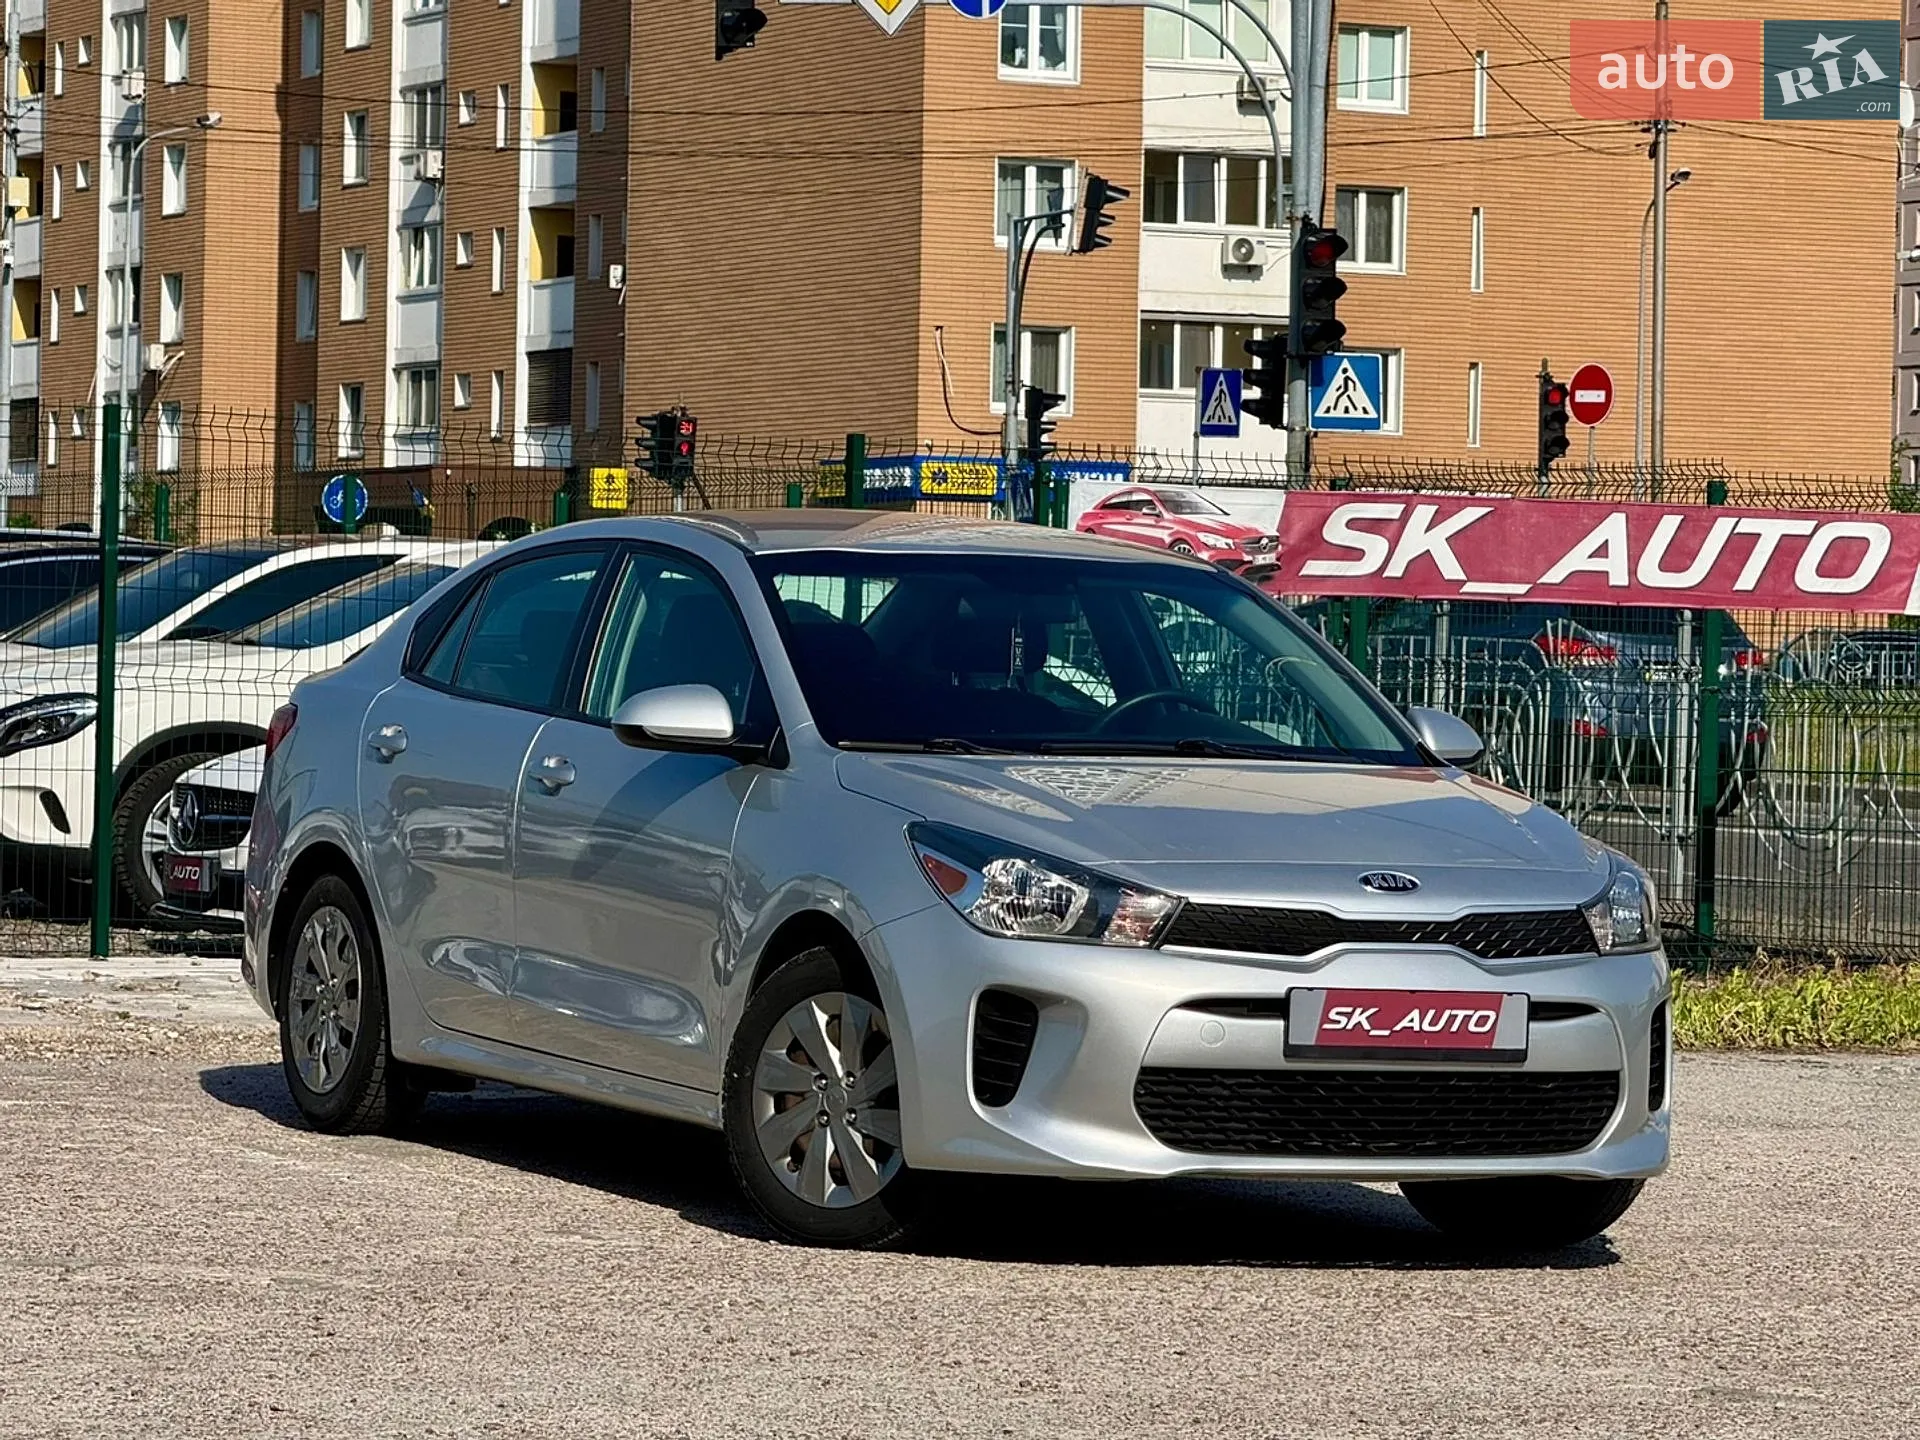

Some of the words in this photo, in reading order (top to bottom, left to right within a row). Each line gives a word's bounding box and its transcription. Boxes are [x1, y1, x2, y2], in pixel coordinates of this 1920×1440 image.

[1298, 502, 1892, 595] SK_AUTO
[1367, 874, 1413, 889] KIA
[1321, 1006, 1497, 1036] SK_AUTO
